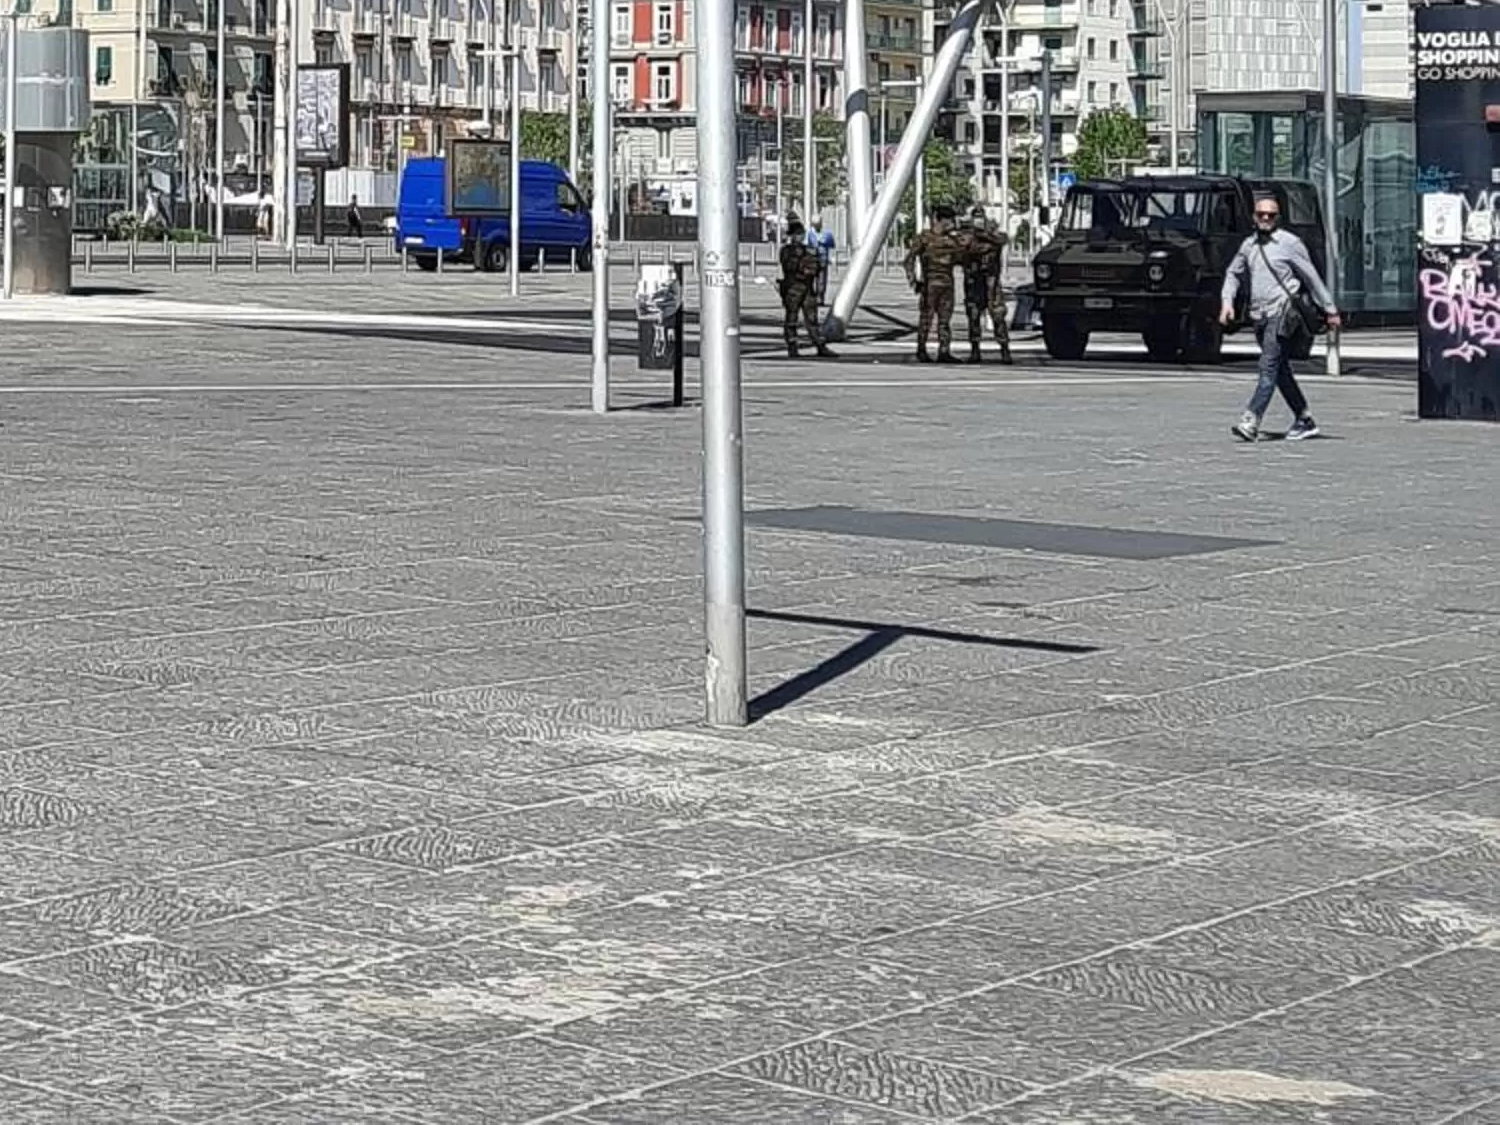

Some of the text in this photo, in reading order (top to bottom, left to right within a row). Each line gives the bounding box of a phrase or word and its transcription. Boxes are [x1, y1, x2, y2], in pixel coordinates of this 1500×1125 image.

[1417, 31, 1491, 48] VOGLIA
[1417, 49, 1499, 66] SHOPPIN
[1417, 66, 1442, 80] GO
